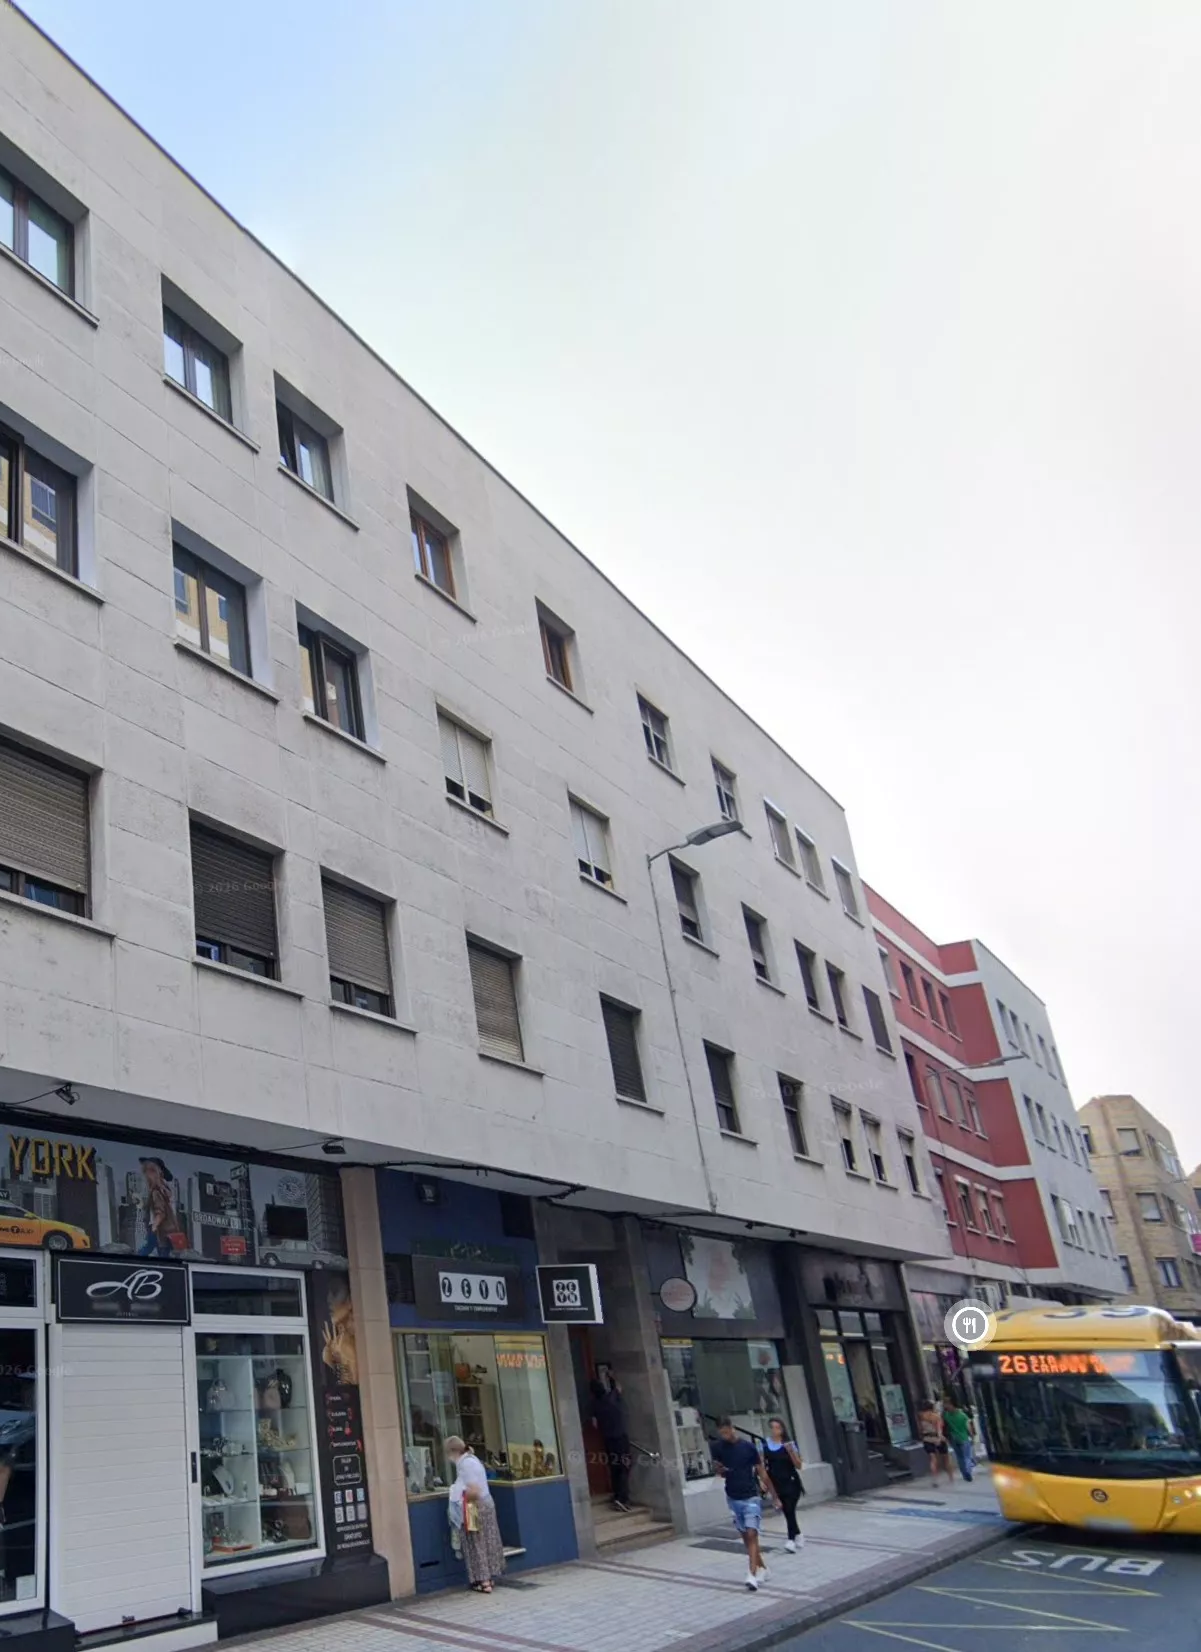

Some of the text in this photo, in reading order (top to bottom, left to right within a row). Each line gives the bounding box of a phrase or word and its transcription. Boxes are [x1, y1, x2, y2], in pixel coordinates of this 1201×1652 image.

[8, 1133, 97, 1182] YORK
[86, 1268, 164, 1301] AB
[998, 1354, 1029, 1374] 26
[999, 1550, 1164, 1576] BUS
